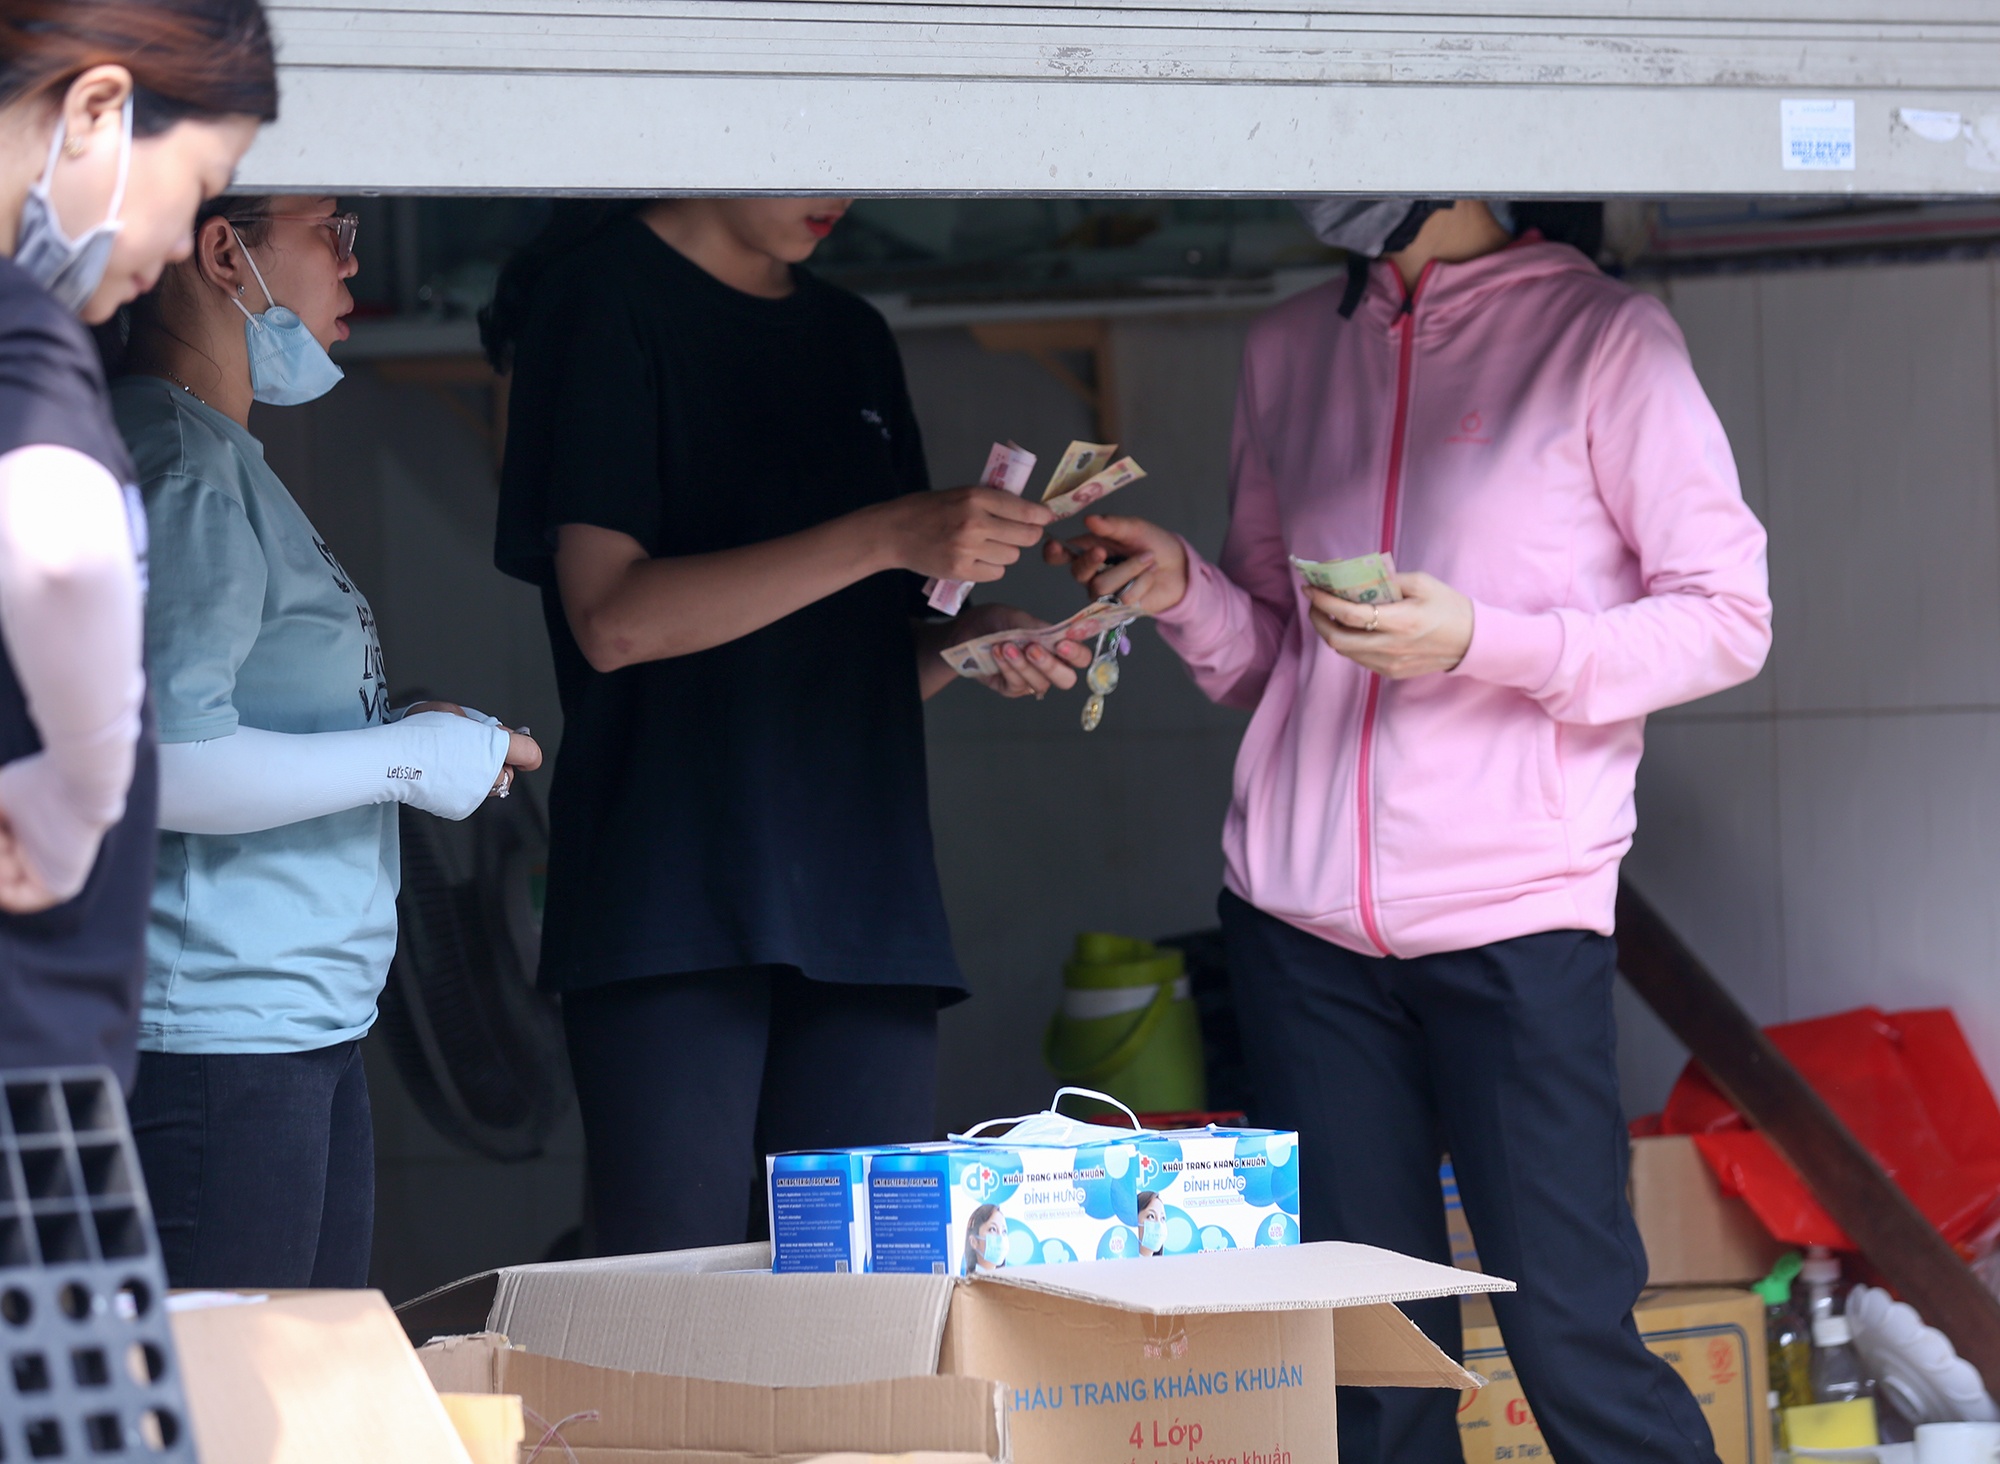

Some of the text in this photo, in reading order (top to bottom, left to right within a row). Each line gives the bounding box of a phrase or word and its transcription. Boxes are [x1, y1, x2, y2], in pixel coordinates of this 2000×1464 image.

[1186, 1161, 1211, 1170] TRANG
[1026, 1173, 1051, 1182] TRANG
[1213, 1176, 1244, 1191] HƯNG
[1053, 1189, 1085, 1203] HƯNG
[1070, 1378, 1147, 1407] TRANG
[1153, 1368, 1228, 1399] KHÁNG
[1129, 1417, 1203, 1452] 4 Lớp
